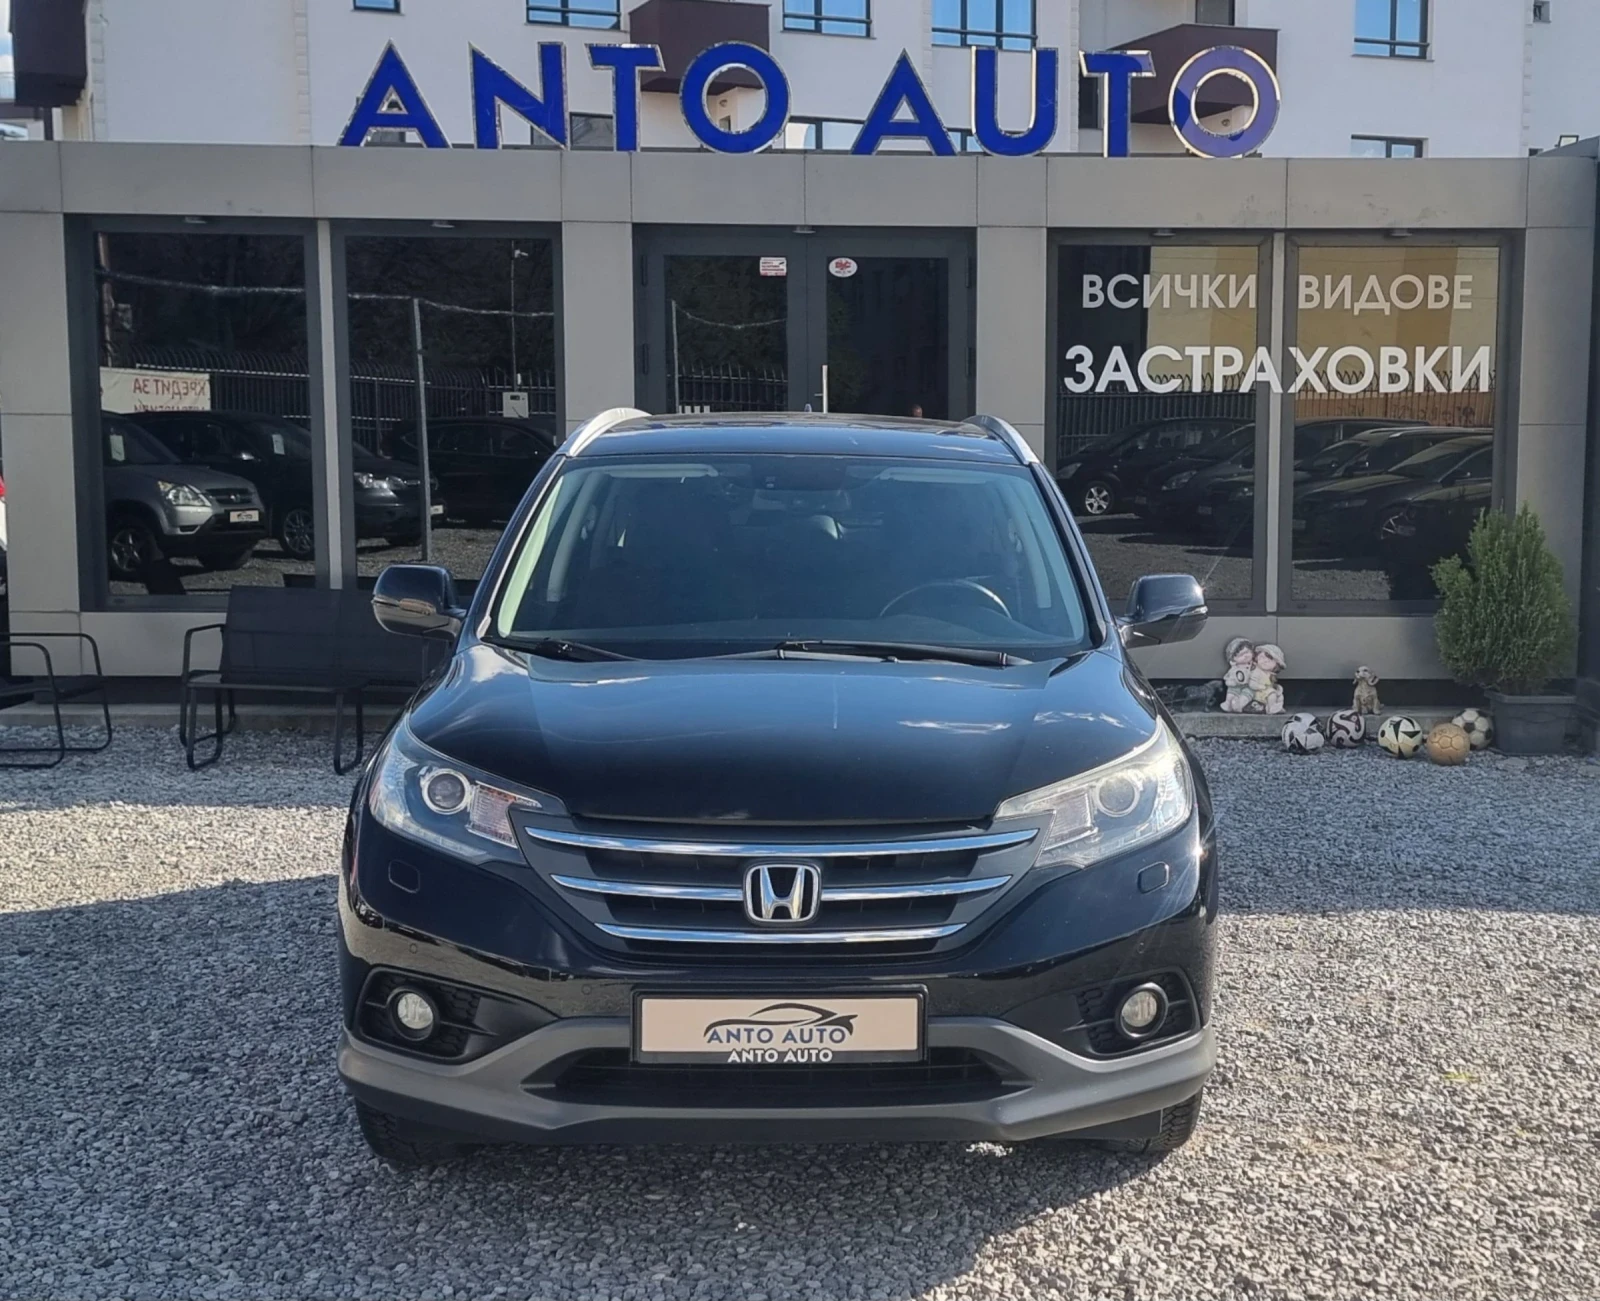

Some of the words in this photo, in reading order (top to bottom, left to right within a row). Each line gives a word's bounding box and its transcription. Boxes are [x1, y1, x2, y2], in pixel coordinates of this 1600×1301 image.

[336, 37, 792, 154] ANTO
[850, 45, 1281, 158] AUTO
[1082, 273, 1257, 309] ВСИЧКИ
[1298, 274, 1473, 316] ВИДОВЕ
[1063, 344, 1491, 395] ЗАСТРАХОВКИ
[706, 1027, 773, 1044] ANTO
[781, 1027, 846, 1044] AUTO
[727, 1049, 778, 1063] ANTO
[783, 1049, 833, 1063] AUTO
